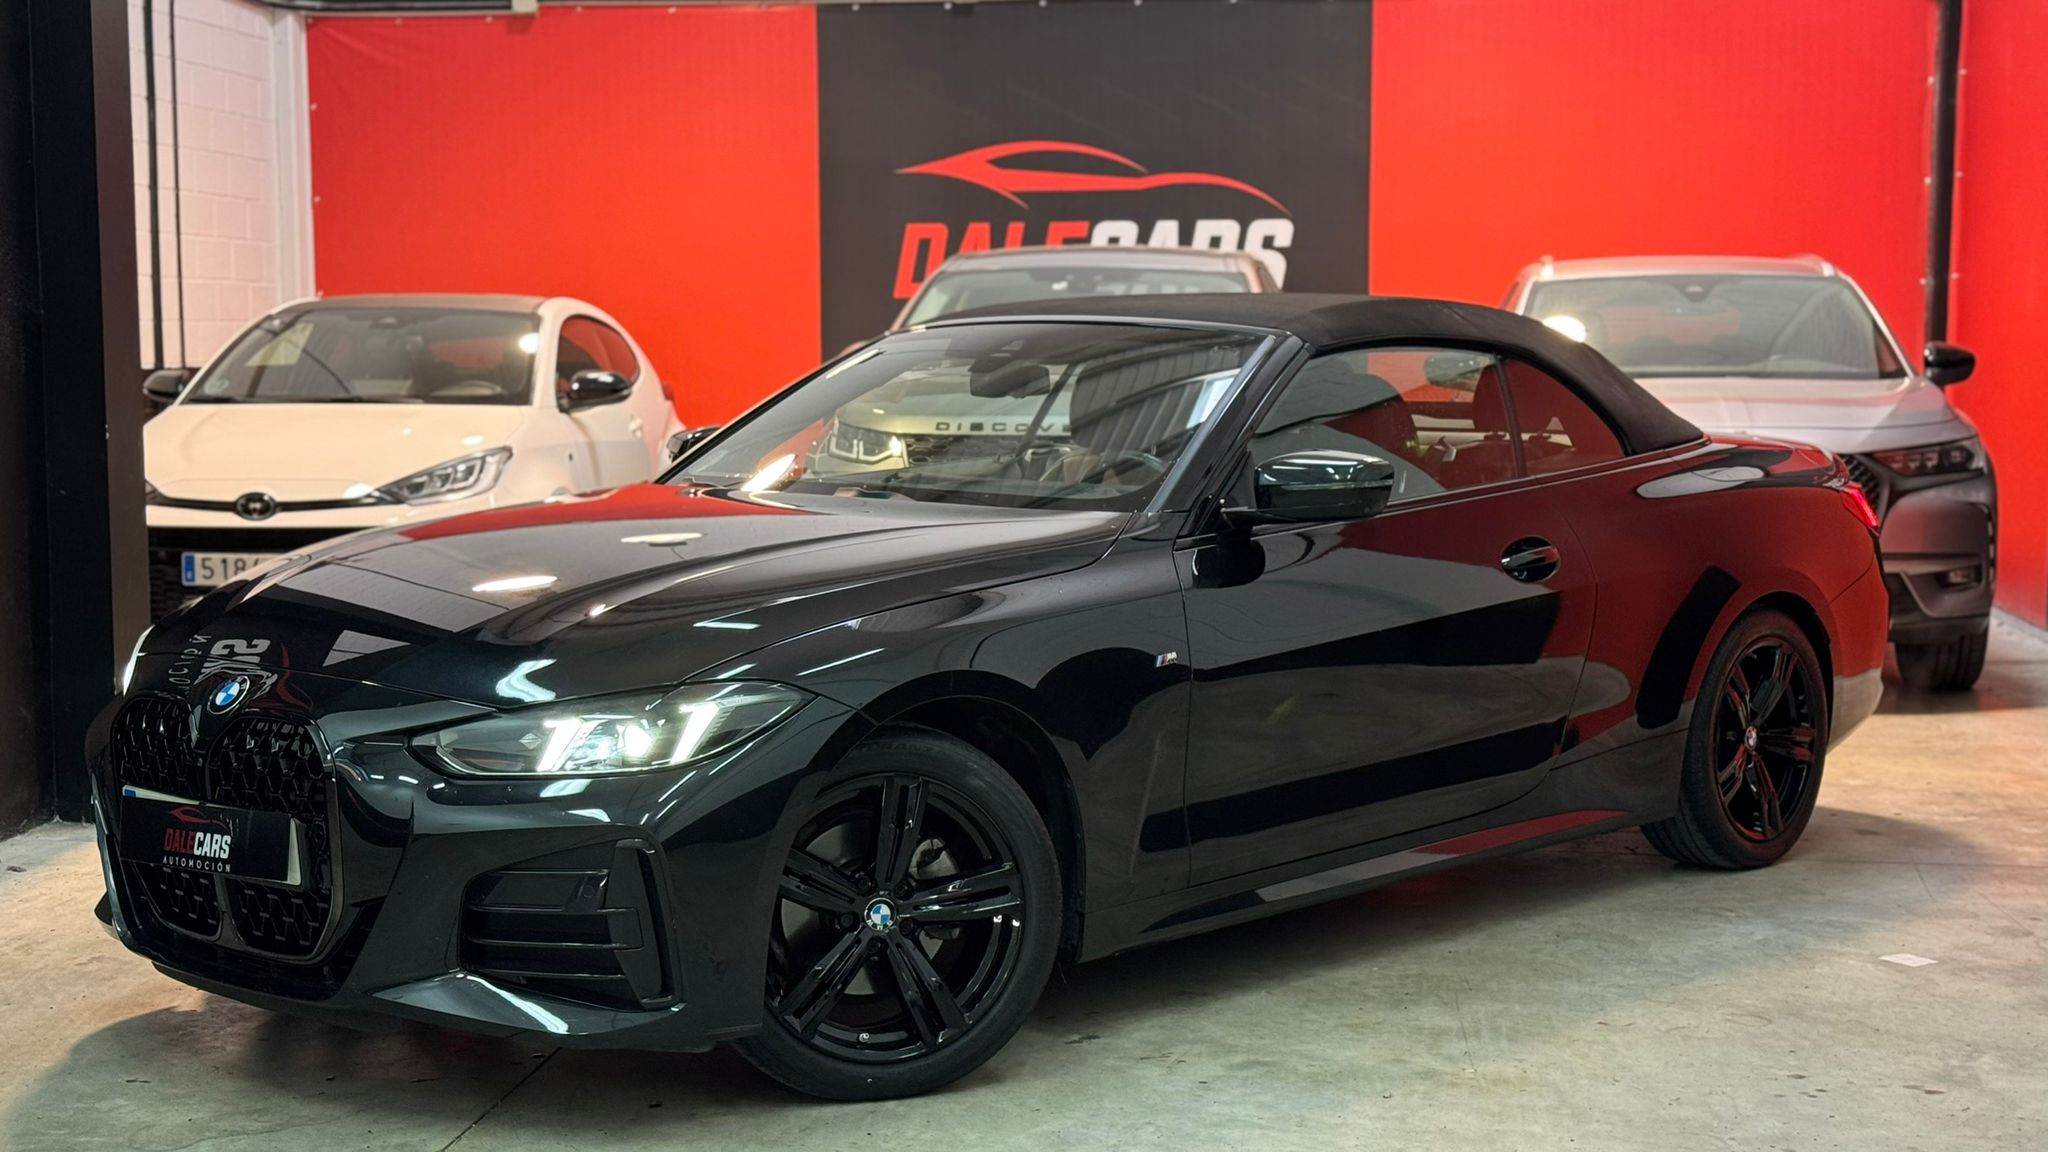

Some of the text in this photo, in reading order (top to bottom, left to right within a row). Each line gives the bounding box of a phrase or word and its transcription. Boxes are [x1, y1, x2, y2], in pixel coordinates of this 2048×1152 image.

[201, 557, 259, 580] 518
[163, 827, 232, 859] DALECARS
[162, 855, 232, 873] AUTOMOCIÓN
